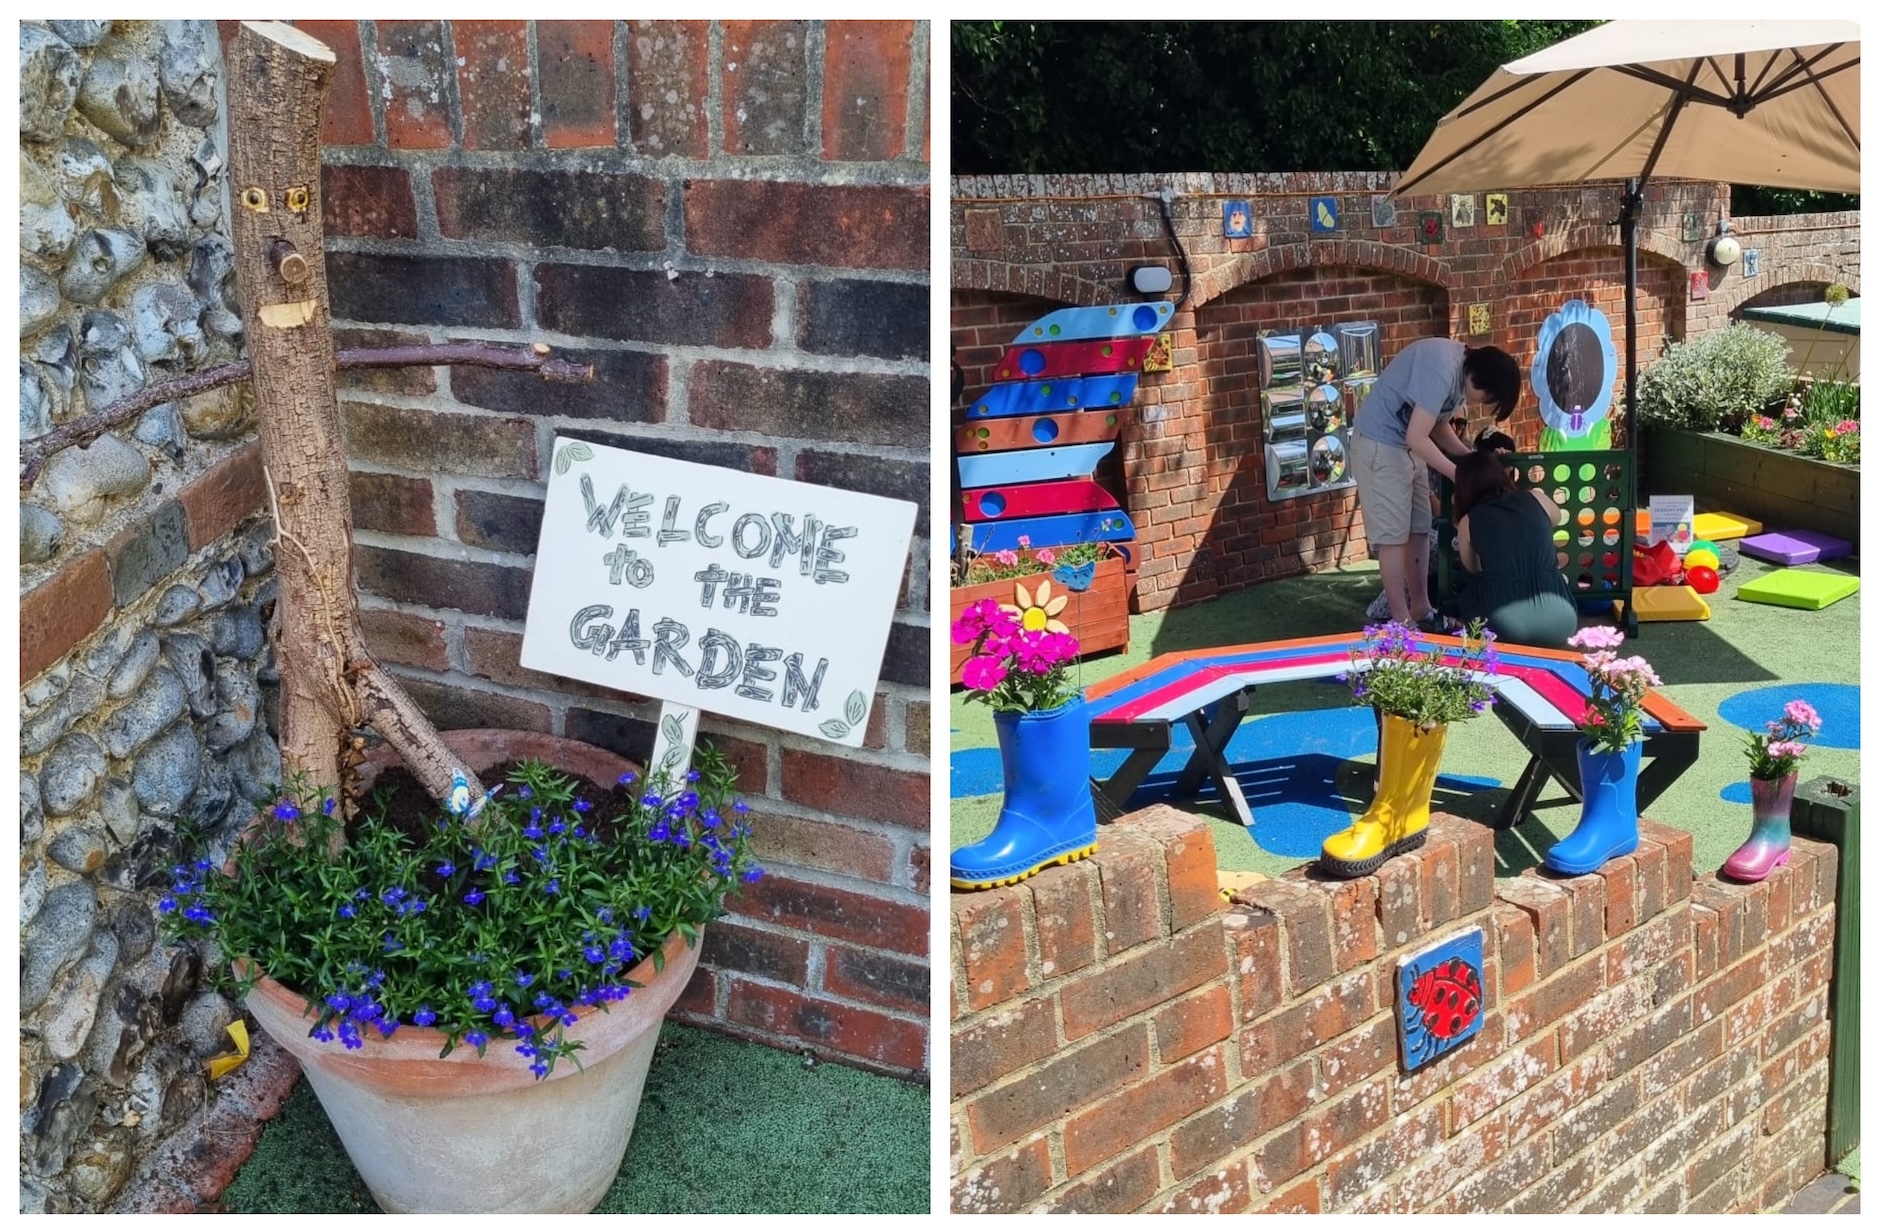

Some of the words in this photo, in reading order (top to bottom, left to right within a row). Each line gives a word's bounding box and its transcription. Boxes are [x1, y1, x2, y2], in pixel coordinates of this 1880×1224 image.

[579, 473, 859, 585] WELCOME
[603, 542, 655, 589] to
[695, 563, 782, 617] THE
[569, 604, 830, 713] GARDEN
